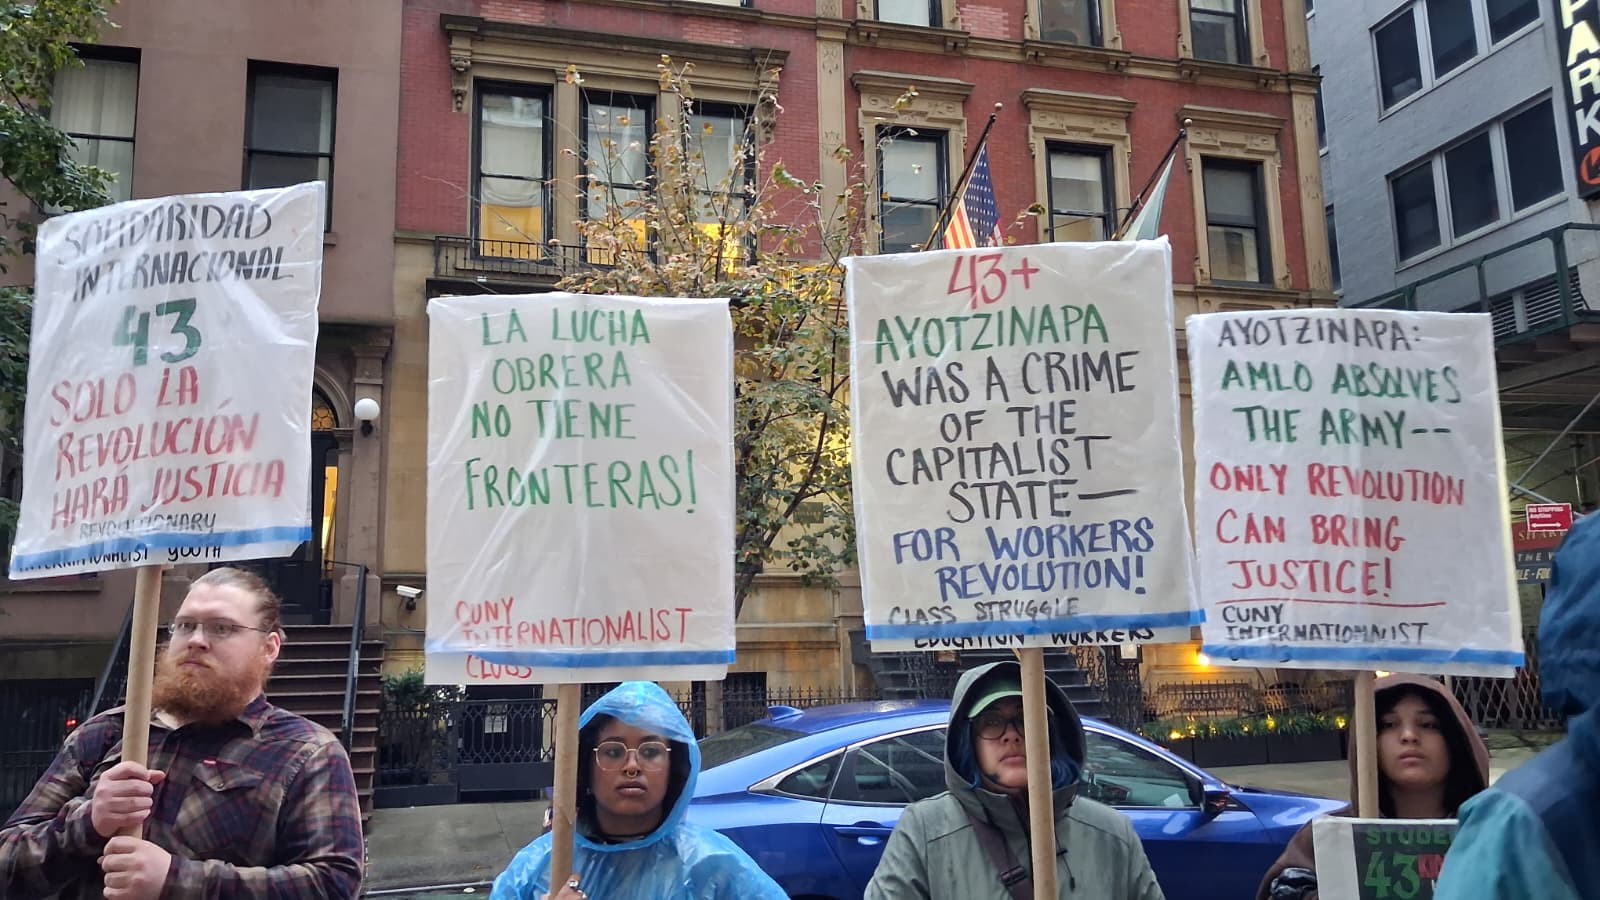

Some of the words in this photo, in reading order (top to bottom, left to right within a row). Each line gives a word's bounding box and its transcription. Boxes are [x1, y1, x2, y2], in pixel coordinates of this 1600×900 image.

[1559, 0, 1600, 146] PARK
[57, 202, 272, 265] SOLIDARIDAD
[73, 247, 293, 302] INTERNACIONAL
[946, 252, 1041, 310] 43+
[112, 298, 201, 366] 43
[481, 308, 528, 346] LA
[551, 308, 651, 346] LUCHA
[875, 304, 1109, 364] AYOTZINAPA
[1217, 316, 1422, 350] AYOTZINAPA:
[50, 371, 136, 428] SOLO
[156, 366, 200, 408] LA
[492, 351, 631, 395] OBRERA
[882, 361, 970, 408] WAS
[985, 356, 1010, 403] A
[1022, 350, 1140, 396] CRIME
[1221, 360, 1313, 392] AMLO
[1331, 361, 1461, 403] ABSOLVES
[55, 399, 260, 482] REVOLUCIÓN
[471, 400, 511, 439] NO
[527, 399, 637, 440] TIENE
[940, 409, 986, 443] OF
[1006, 400, 1077, 438] THE
[1232, 405, 1301, 442] THE
[464, 449, 698, 514] FRONTERAS!
[886, 435, 1112, 486] CAPITALIST
[1209, 462, 1288, 495] ONLY
[1307, 462, 1465, 505] REVOLUTION
[51, 465, 129, 530] HARÁ
[140, 459, 286, 511] JUSTICIA
[893, 526, 961, 565] FOR
[986, 516, 1155, 562] WORKERS
[1216, 508, 1286, 544] CAN
[1311, 514, 1406, 551] BRING
[935, 554, 1147, 602] REVOLUTION!
[1227, 558, 1393, 597] JUSTICE!
[455, 597, 515, 628] CUNY
[888, 604, 958, 627] CLASS
[975, 597, 1080, 623] STRUGGLE
[1222, 602, 1286, 626] CUNY
[1366, 826, 1452, 845] STUDE
[1364, 851, 1421, 900] 43
